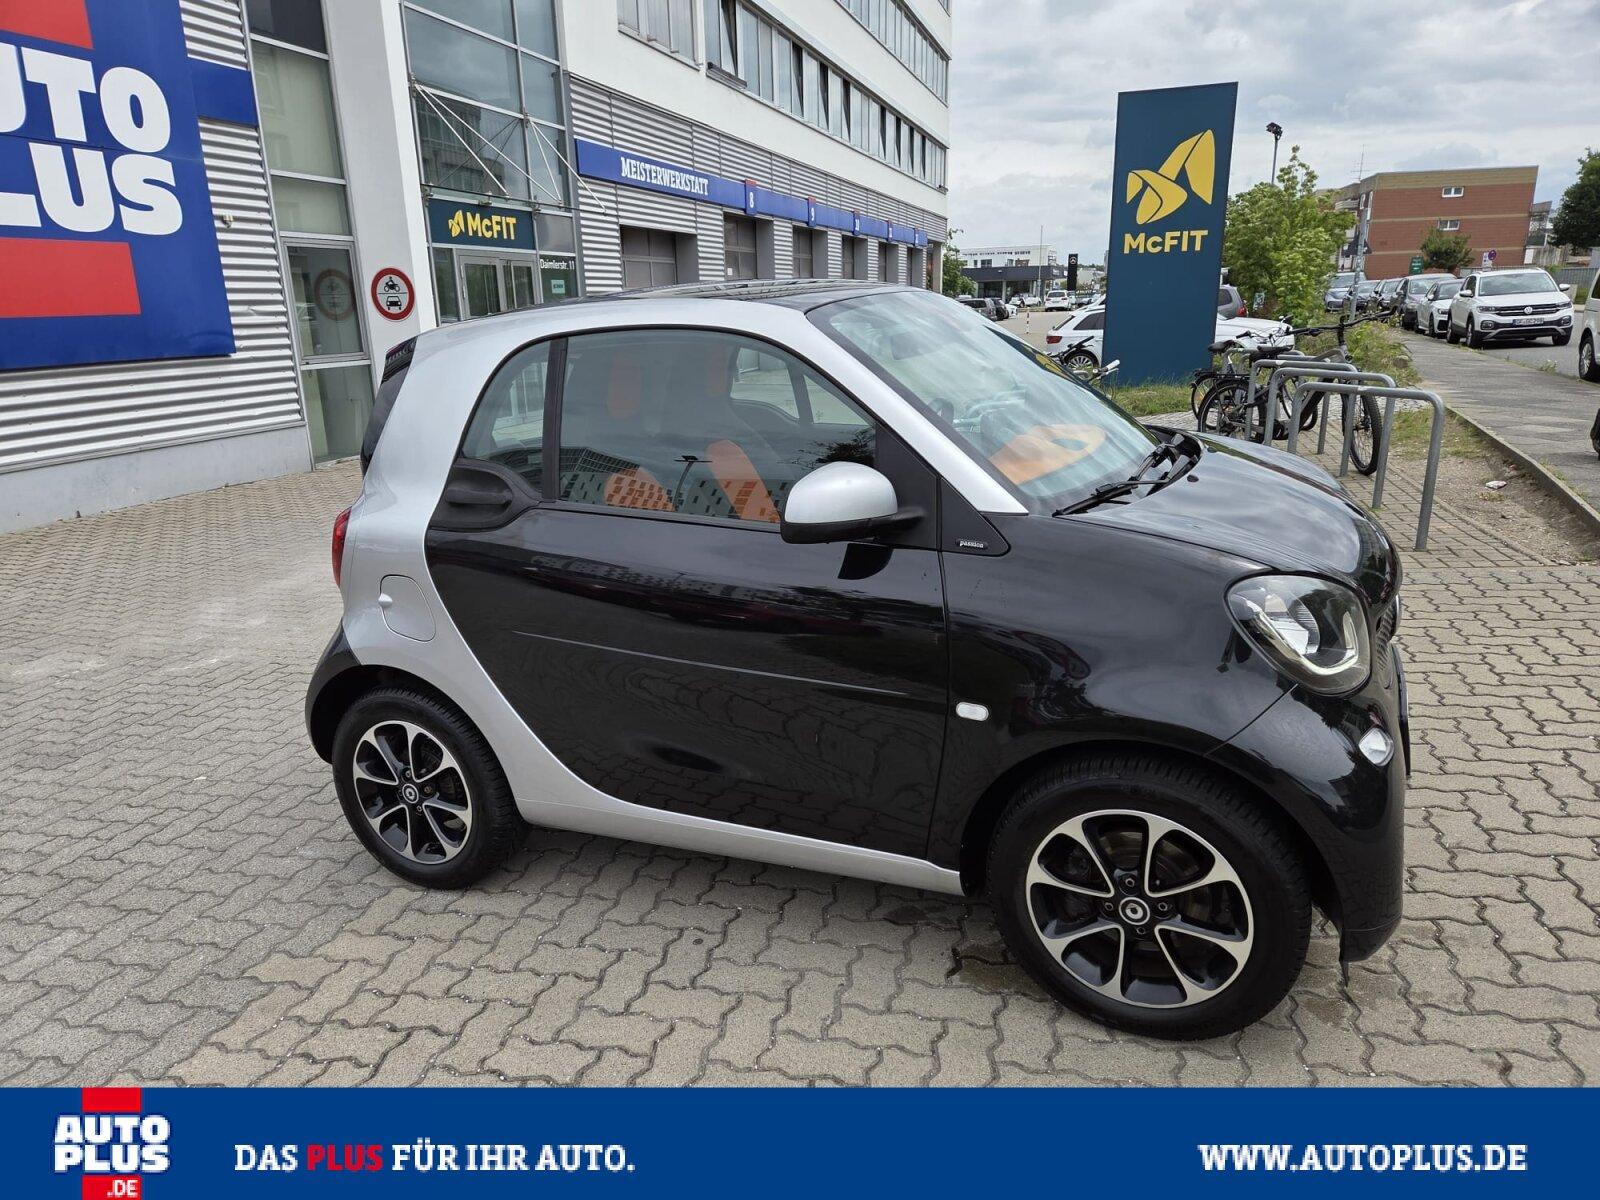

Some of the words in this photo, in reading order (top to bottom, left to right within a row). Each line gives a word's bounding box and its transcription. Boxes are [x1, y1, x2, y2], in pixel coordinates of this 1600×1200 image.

[620, 157, 709, 195] MEISTERWERKSTATT
[750, 192, 755, 208] 8
[466, 211, 517, 240] McFIT
[1123, 230, 1209, 254] McFIT
